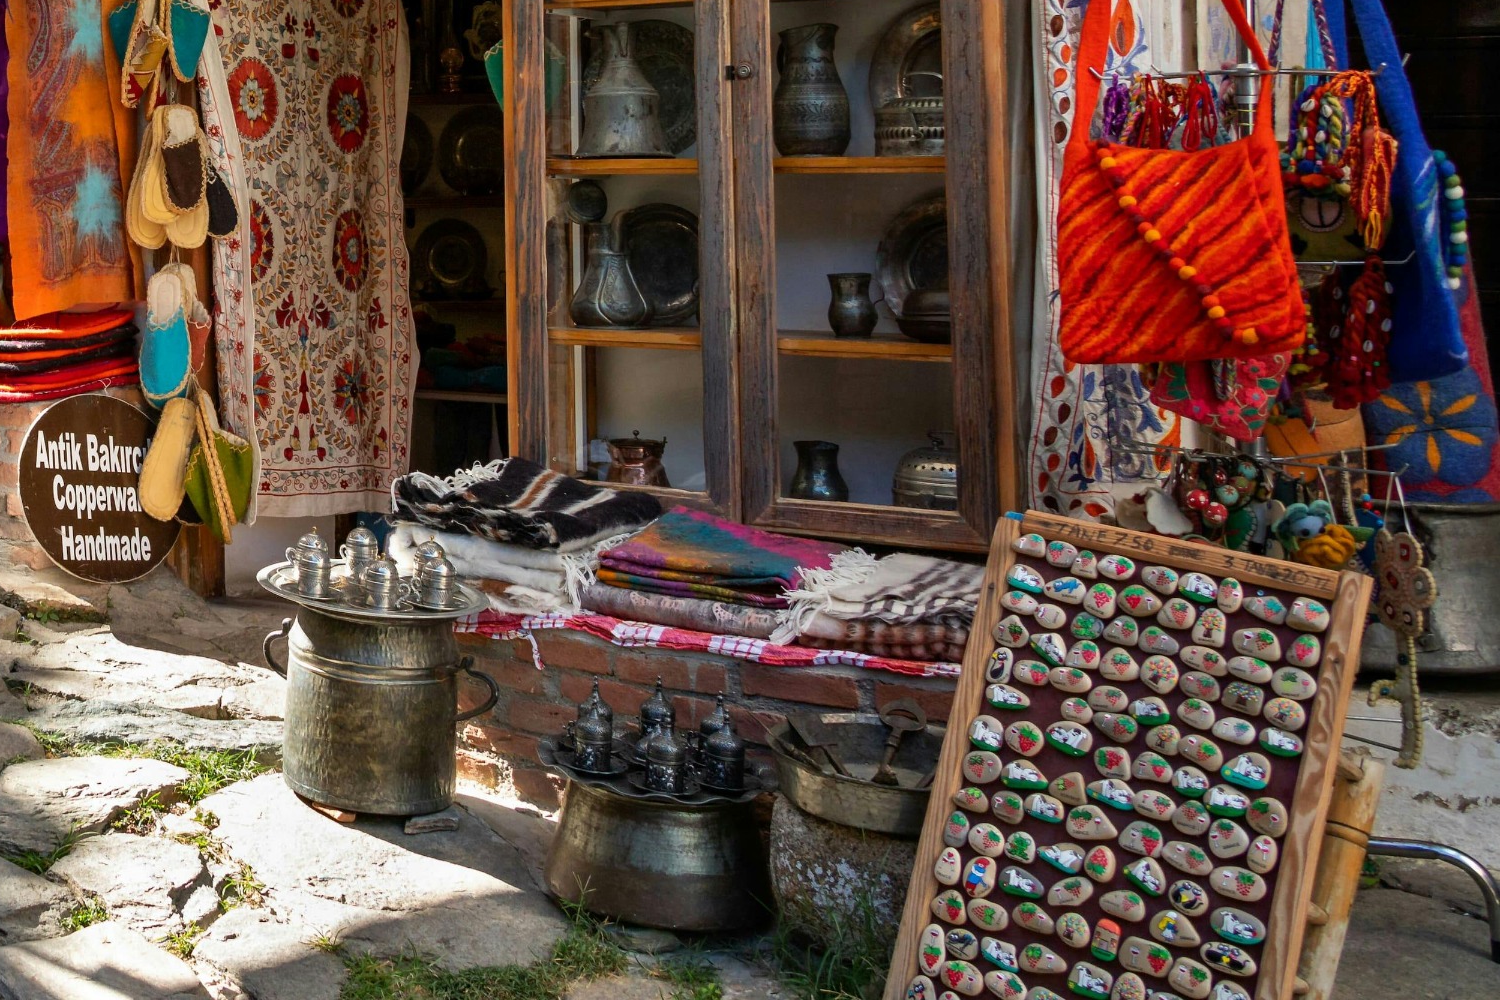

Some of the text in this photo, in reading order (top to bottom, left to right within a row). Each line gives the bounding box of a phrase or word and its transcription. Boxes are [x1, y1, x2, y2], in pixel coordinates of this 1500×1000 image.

[35, 430, 83, 471] Antik
[52, 474, 142, 520] Copperwa
[61, 525, 151, 561] Handmade
[1221, 554, 1235, 569] 3
